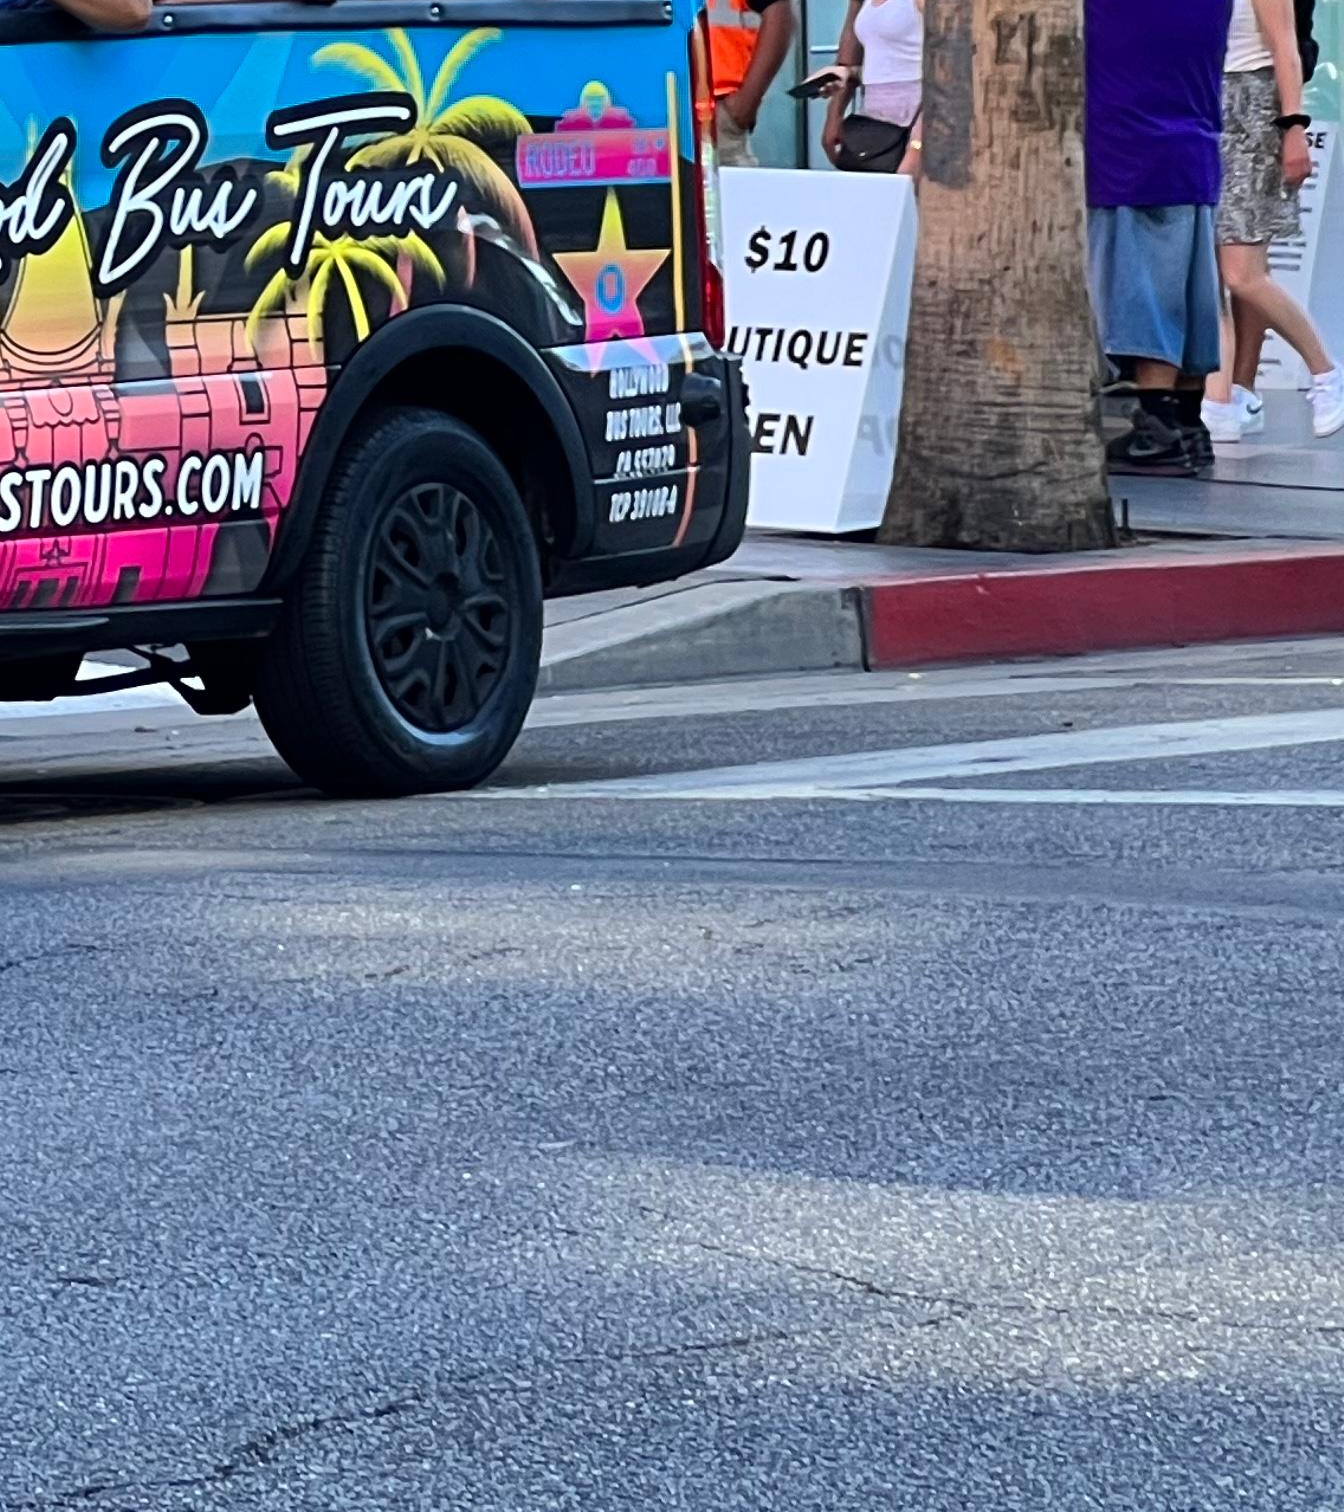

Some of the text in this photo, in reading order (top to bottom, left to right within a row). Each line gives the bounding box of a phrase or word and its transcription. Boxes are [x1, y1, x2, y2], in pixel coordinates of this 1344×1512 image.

[100, 113, 257, 287] Bus
[273, 105, 458, 267] Tours
[744, 225, 830, 274] $10
[727, 326, 869, 369] UTIQUE
[752, 412, 814, 456] EN
